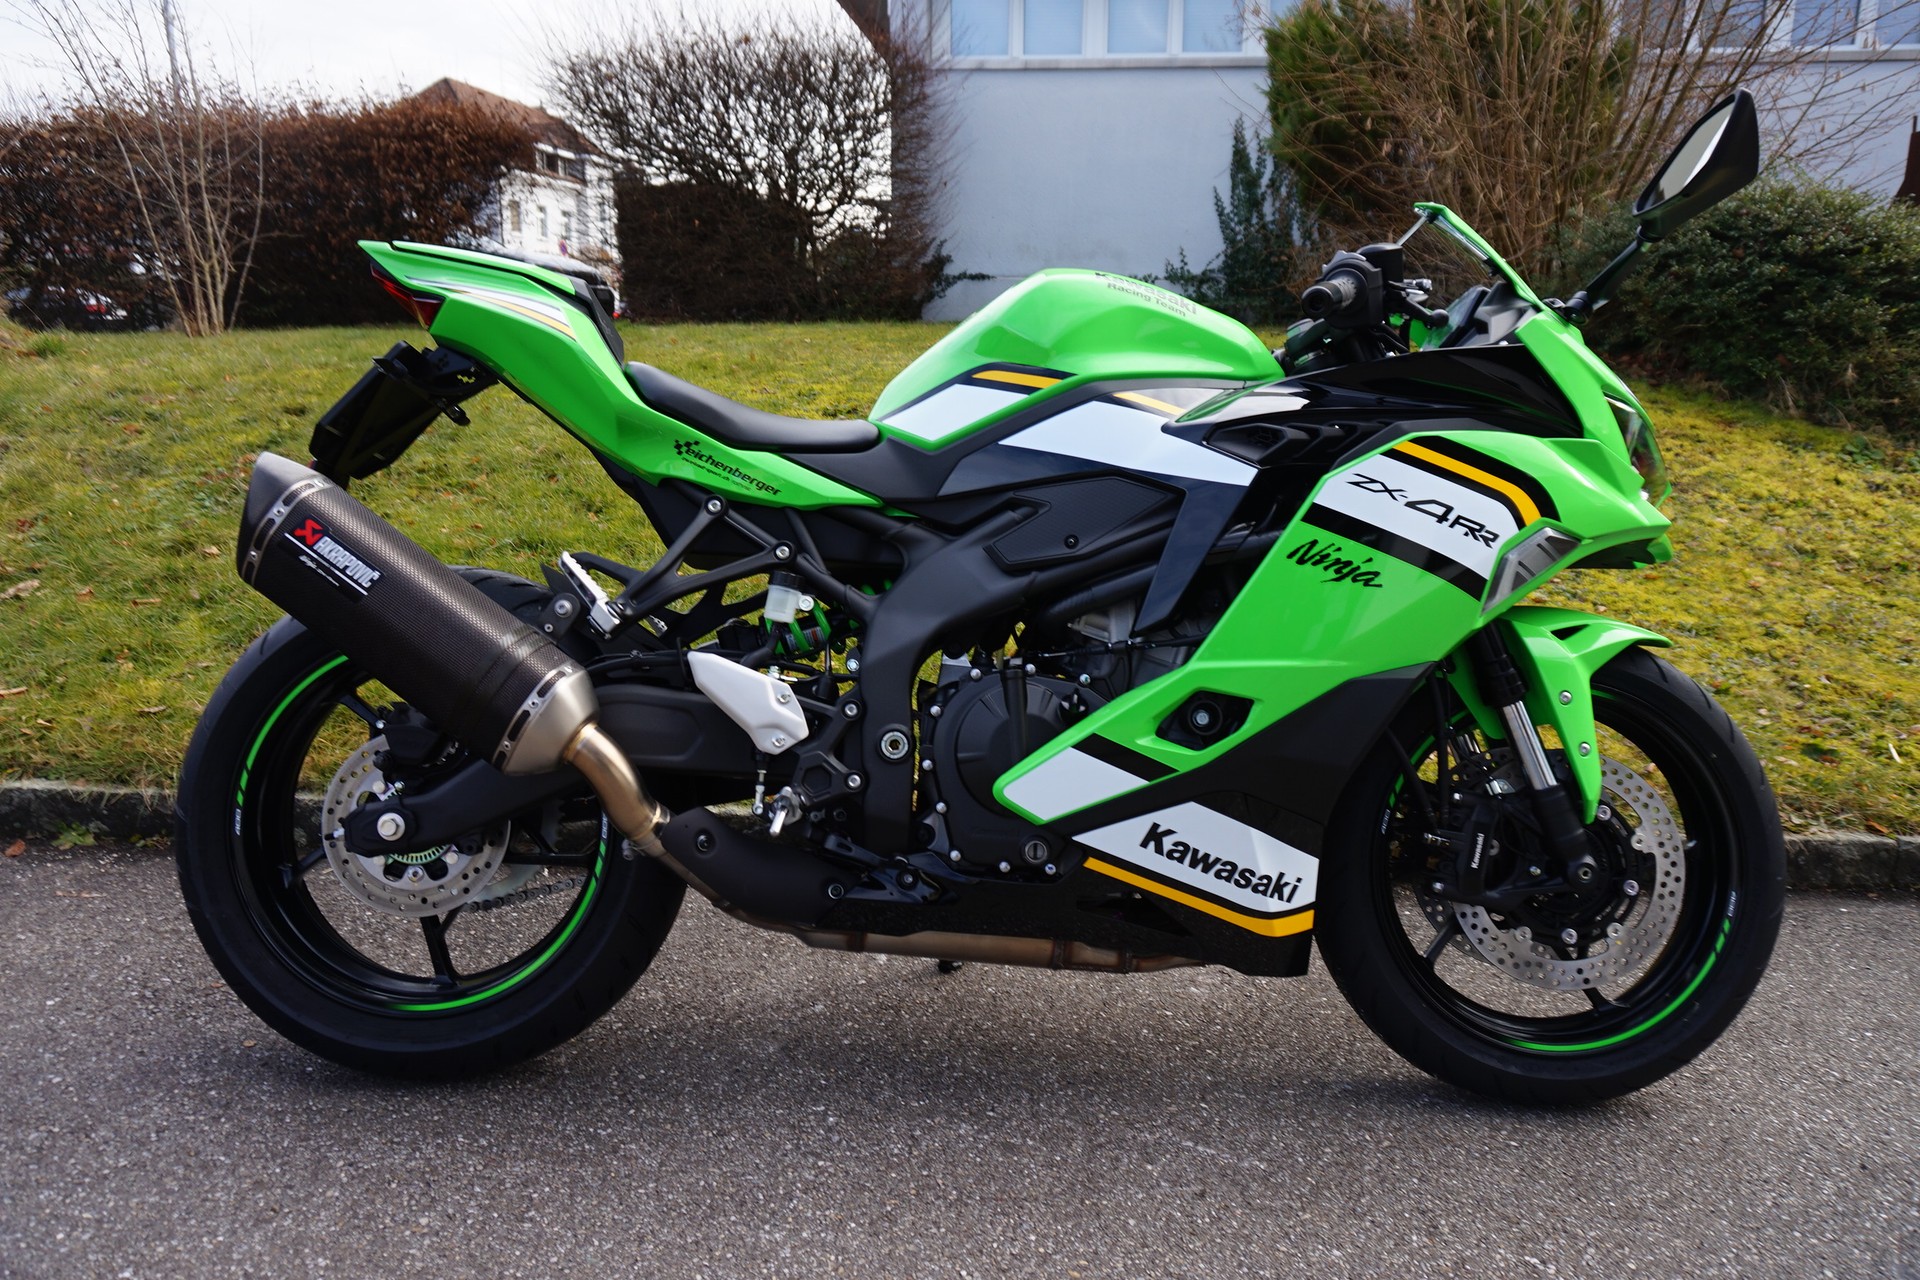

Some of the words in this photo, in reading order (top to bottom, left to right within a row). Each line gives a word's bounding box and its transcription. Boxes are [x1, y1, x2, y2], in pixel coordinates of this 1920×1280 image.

[1107, 282, 1152, 303] Racing
[1153, 297, 1186, 317] Team
[1286, 538, 1383, 588] Ninja
[1139, 821, 1303, 904] Kawasaki
[1470, 832, 1485, 869] Kawasaki
